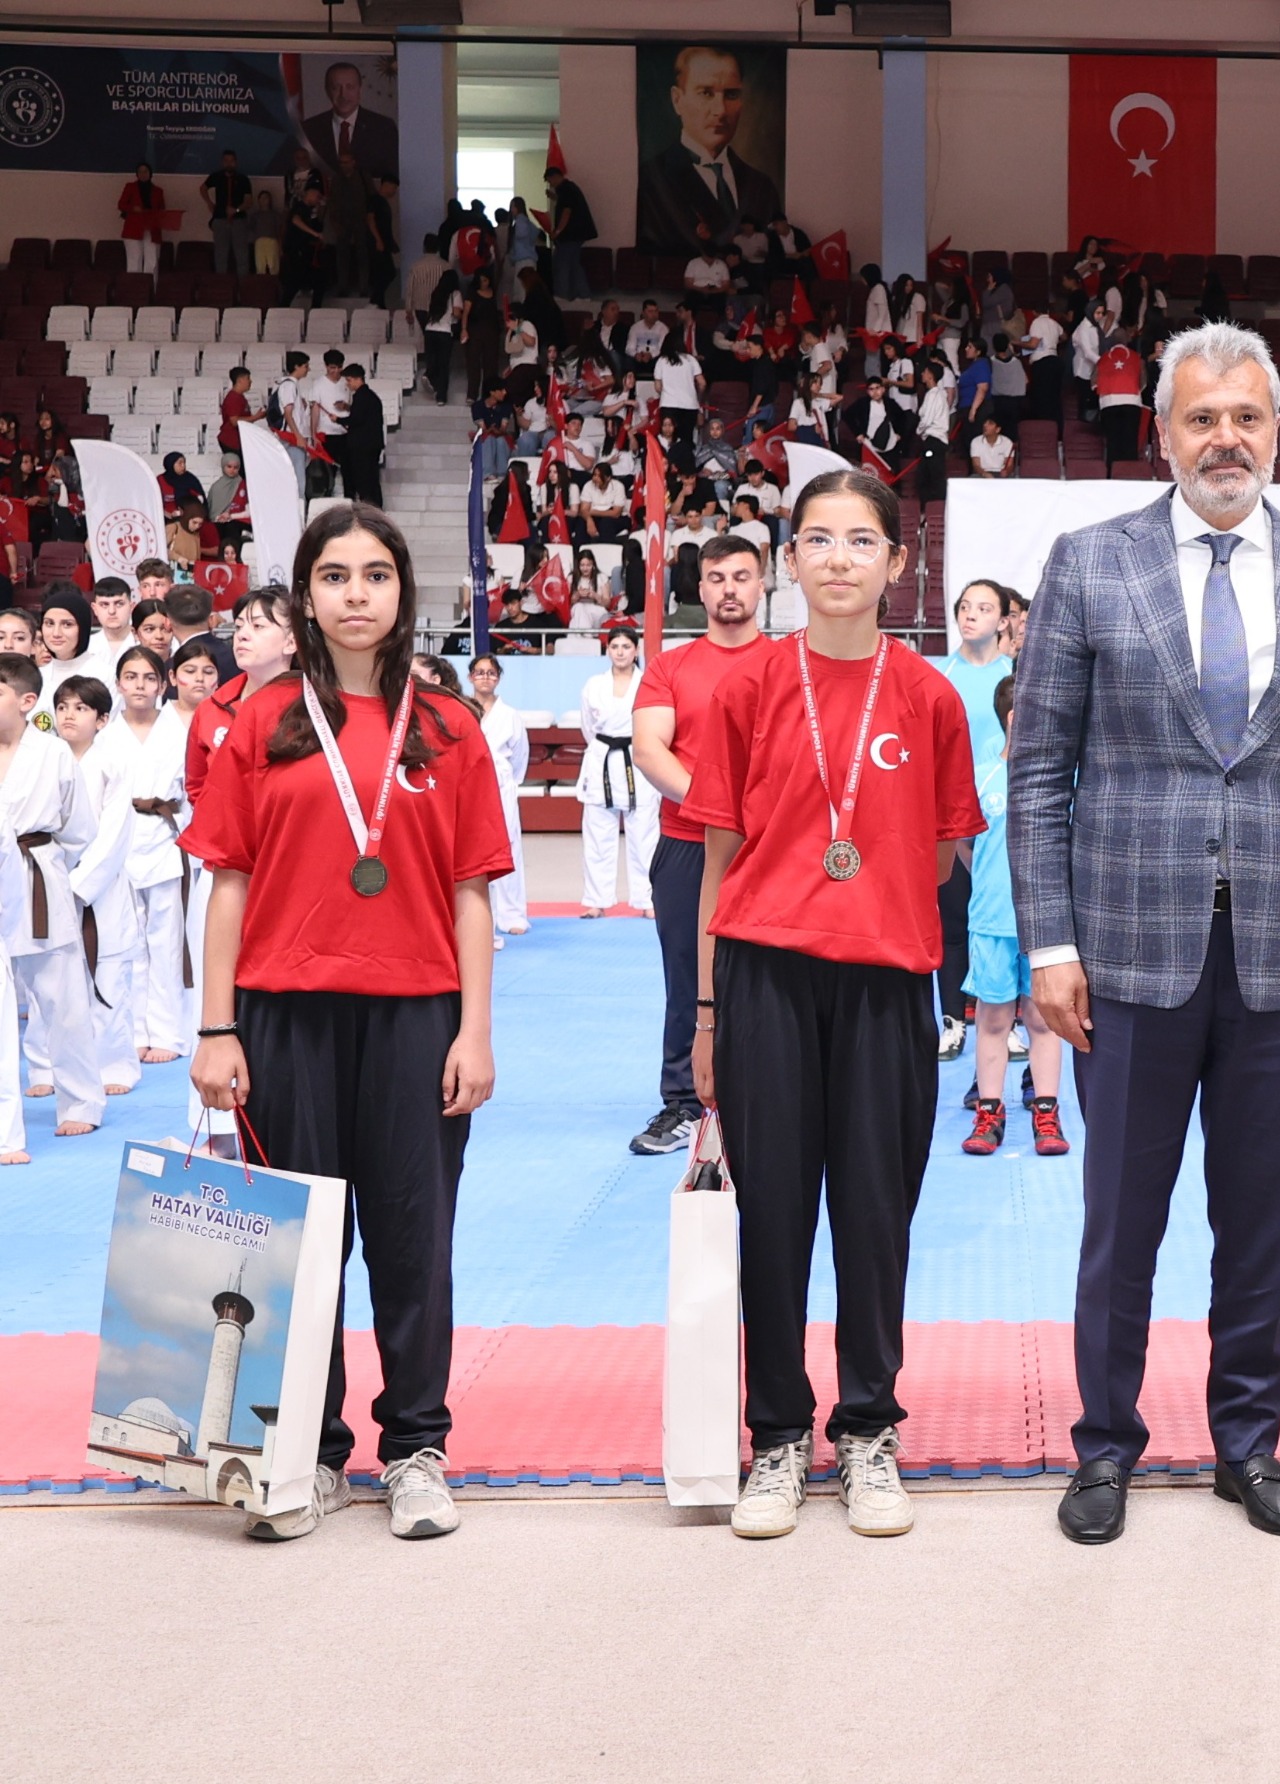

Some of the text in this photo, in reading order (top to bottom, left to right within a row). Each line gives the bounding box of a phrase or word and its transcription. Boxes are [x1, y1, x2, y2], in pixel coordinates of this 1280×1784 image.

[122, 70, 238, 87] TÜM ANTRENÖR
[106, 84, 254, 101] VE SPORCULARIMIZA
[112, 101, 250, 114] BAŞARILAR DİLİYORUM
[794, 639, 812, 684] CUMHURİYETİ
[875, 650, 886, 667] SPOR
[873, 667, 881, 676] VE
[803, 685, 816, 717] GENÇLİK
[863, 677, 880, 710] GENÇLİK
[390, 720, 406, 748] GENÇLİK
[810, 719, 818, 730] VE
[812, 731, 821, 749] SPOR
[852, 710, 873, 761] CUMHURİYETİ
[389, 749, 398, 758] VE
[384, 758, 396, 777] SPOR
[846, 762, 861, 793] TÜRKİYE
[374, 778, 393, 820] BAKANLIĞI
[201, 1184, 227, 1205] T.C.
[152, 1193, 270, 1237] HATAY VALİLİĞİ
[187, 1222, 230, 1243] NECCAR
